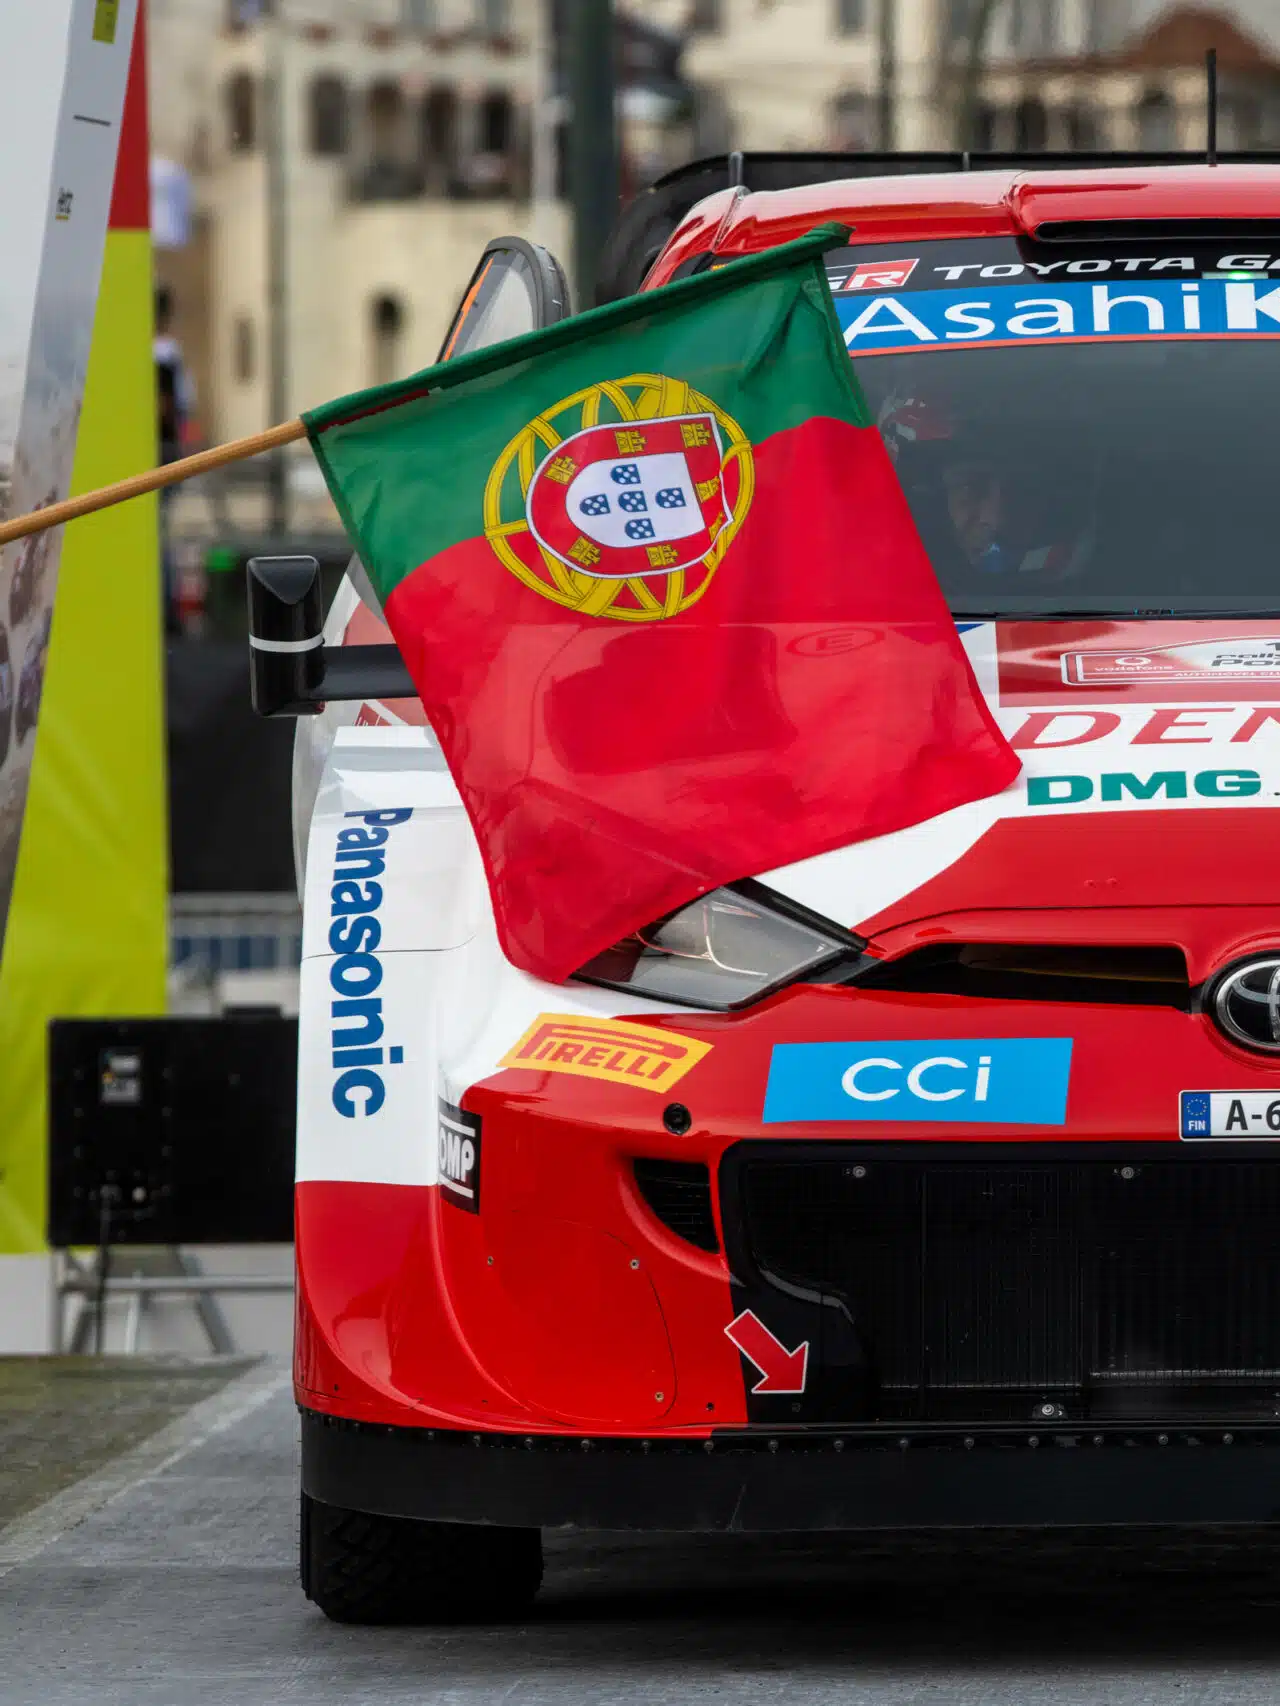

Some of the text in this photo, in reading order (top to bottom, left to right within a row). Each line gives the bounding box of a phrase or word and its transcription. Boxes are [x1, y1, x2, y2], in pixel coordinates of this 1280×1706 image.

[933, 257, 1196, 281] TOYOTA
[1094, 664, 1175, 672] vodafone
[1026, 769, 1262, 806] DMG
[328, 807, 414, 1119] Panasonic
[515, 1023, 689, 1081] PIRELLI
[1188, 1120, 1206, 1131] FIN
[439, 1126, 475, 1184] OMP
